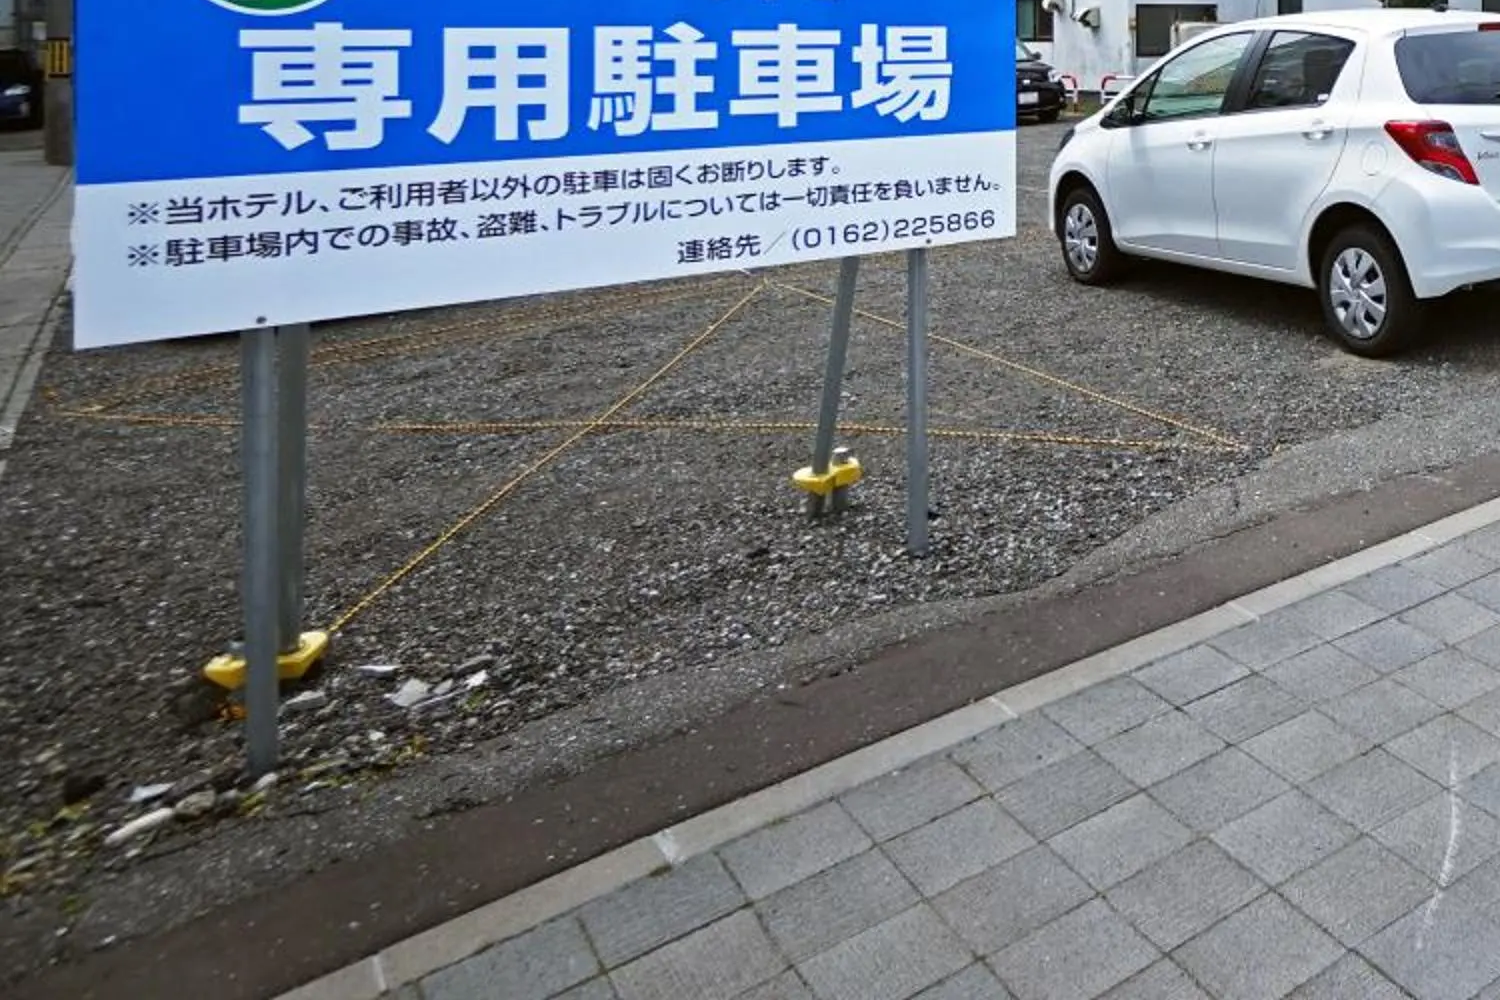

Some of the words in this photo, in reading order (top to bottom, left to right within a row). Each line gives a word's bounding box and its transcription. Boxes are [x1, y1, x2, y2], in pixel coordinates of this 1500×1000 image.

[238, 21, 953, 151] 専用駐車場
